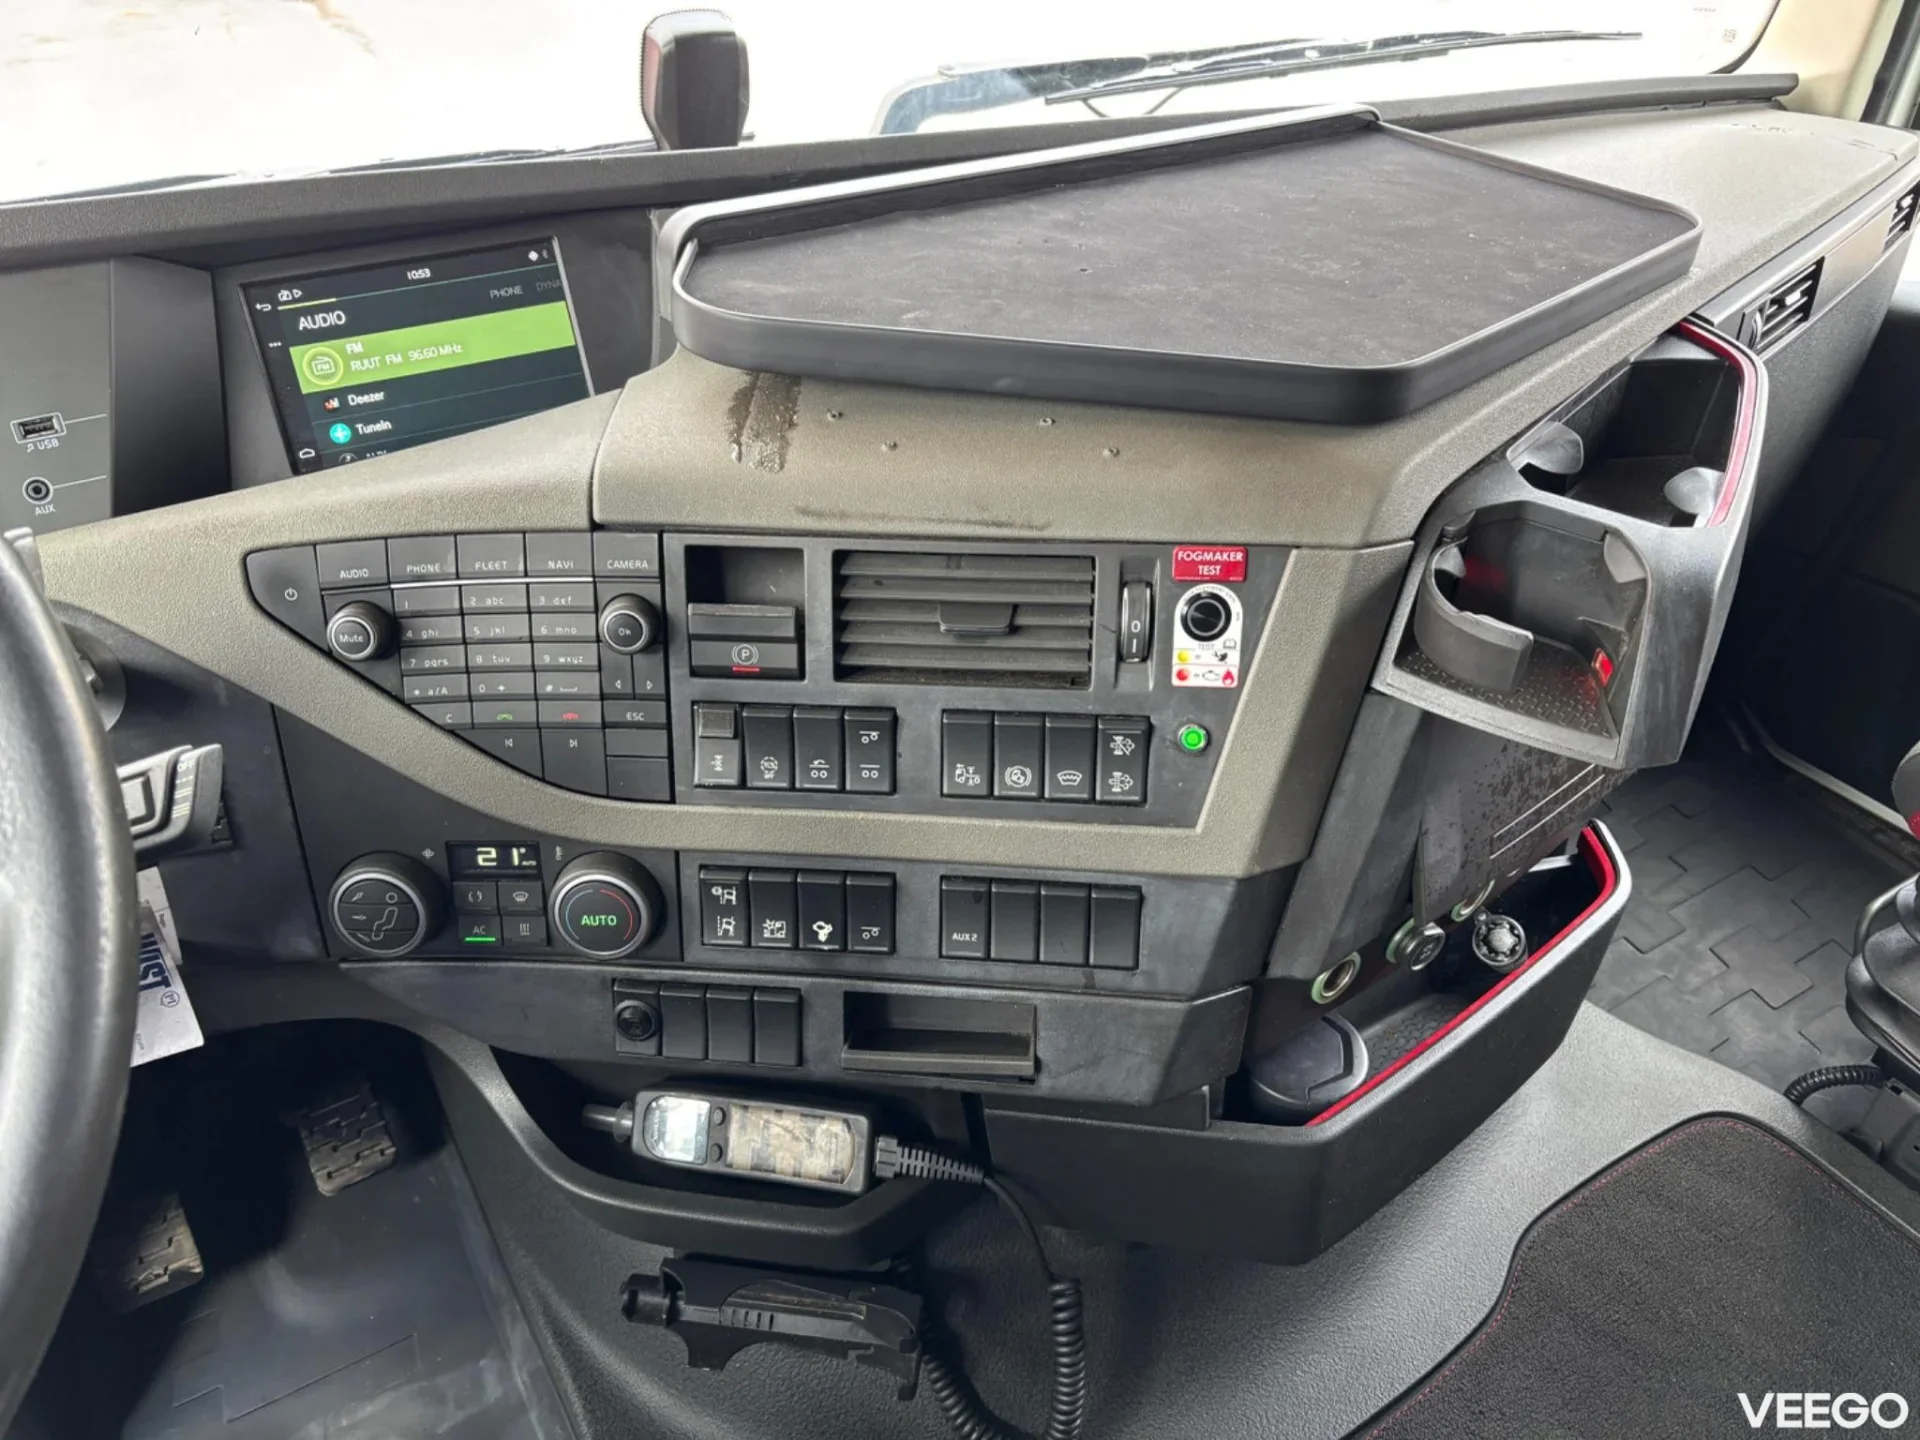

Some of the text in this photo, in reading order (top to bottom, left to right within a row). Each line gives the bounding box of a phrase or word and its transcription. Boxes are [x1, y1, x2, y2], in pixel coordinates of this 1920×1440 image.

[489, 284, 523, 299] PHONE
[298, 310, 346, 331] AUDIO
[345, 341, 364, 355] FM
[350, 357, 381, 372] RUUT
[385, 353, 403, 366] FM
[439, 343, 463, 356] MHz
[347, 390, 386, 406] Deezer
[355, 420, 392, 435] TuneIn
[37, 438, 60, 450] USB
[35, 503, 57, 516] AUX
[1177, 550, 1244, 562] FOGMAKER
[406, 562, 442, 574] PHONE
[475, 560, 508, 571] FLEET
[547, 559, 575, 569] NAVI
[606, 559, 649, 570] CAMERA
[339, 568, 369, 579] AUDIO
[1197, 565, 1222, 575] TEST
[469, 596, 505, 606] 2 abc
[539, 596, 573, 605] 3 def
[406, 628, 439, 640] 4 ghi
[473, 626, 481, 636] 5
[540, 625, 577, 635] 6 mno
[339, 634, 365, 643] Mute
[409, 657, 449, 668] 7 pqrs
[475, 654, 511, 664] 8 tuv
[543, 654, 583, 664] 9 wxyz
[427, 685, 449, 697] a/A
[446, 713, 452, 723] C
[626, 712, 644, 721] ESC
[581, 913, 617, 927] AUTO
[472, 925, 486, 935] AC
[952, 932, 978, 941] AUX 2
